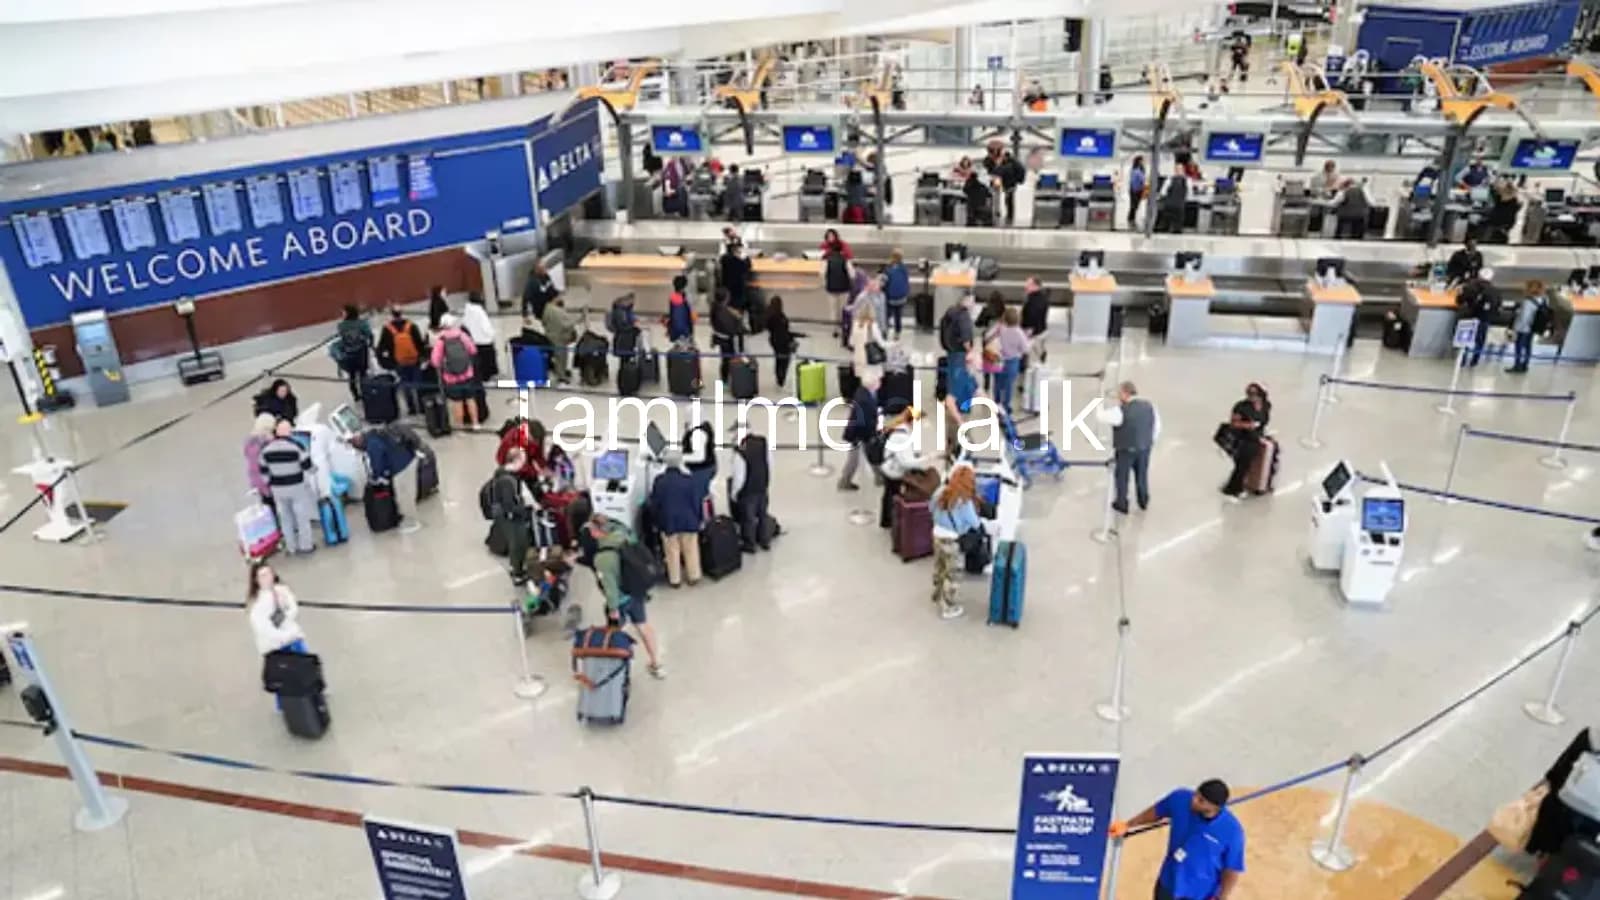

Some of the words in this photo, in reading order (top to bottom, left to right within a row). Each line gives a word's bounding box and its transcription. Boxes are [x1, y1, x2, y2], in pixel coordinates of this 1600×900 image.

[549, 141, 592, 181] DELTA
[50, 237, 269, 301] WELCOME
[282, 208, 433, 261] ABOARD
[1047, 763, 1097, 773] DELTA
[389, 831, 432, 846] DELTA
